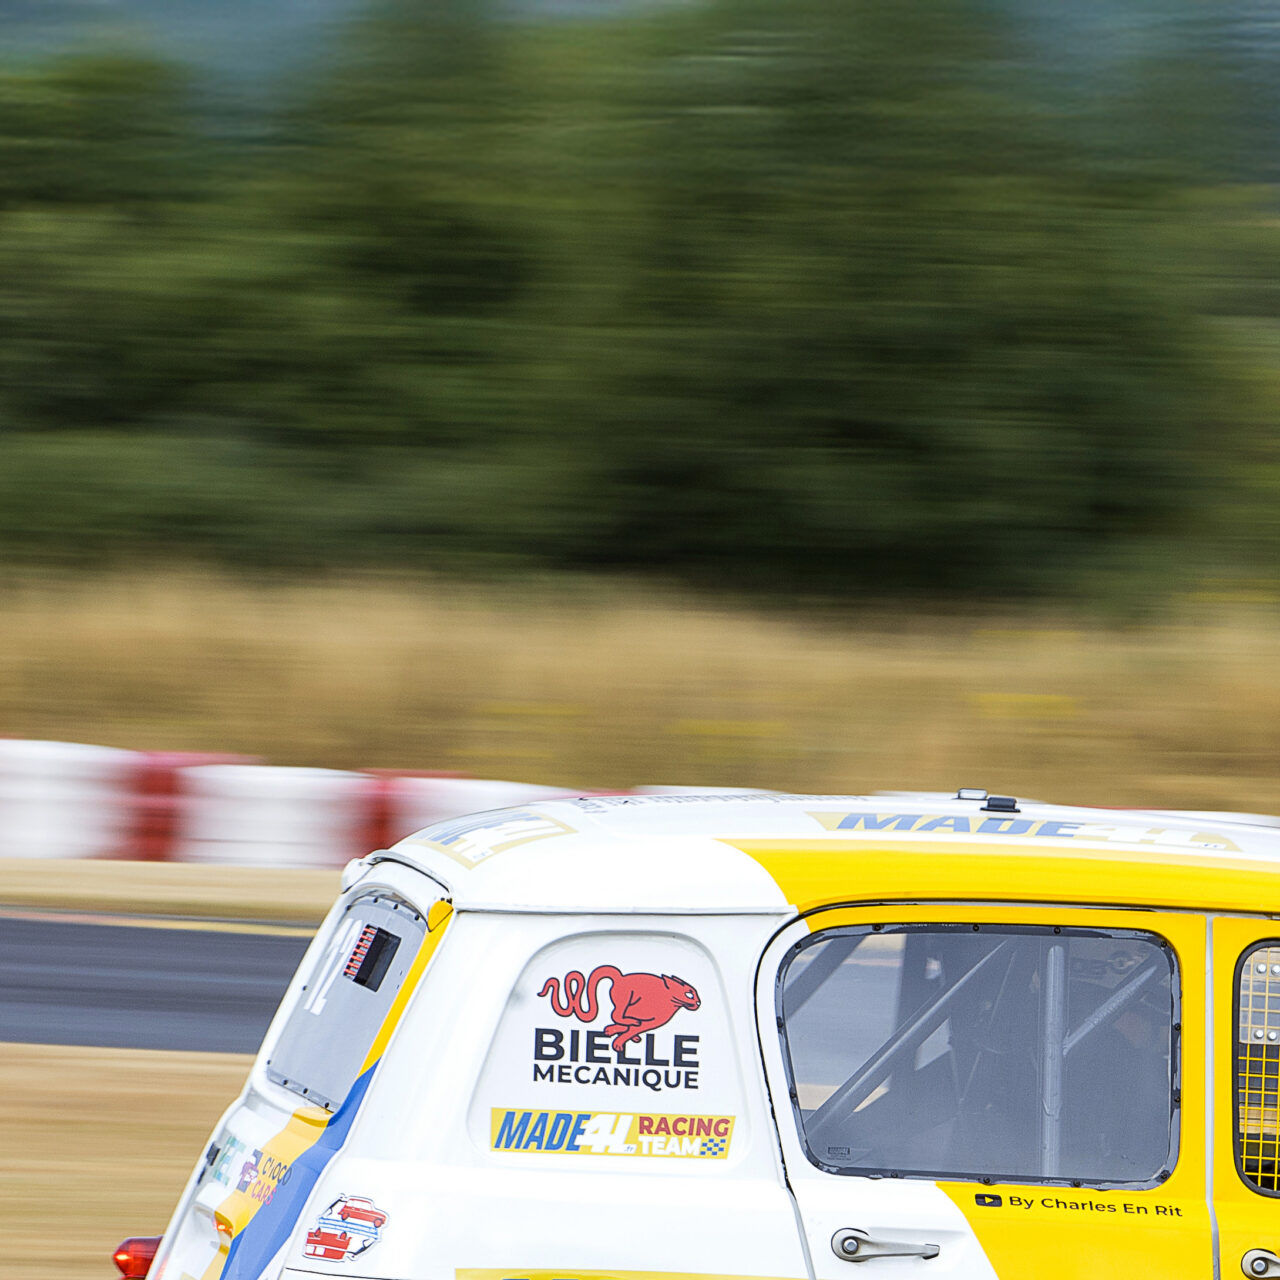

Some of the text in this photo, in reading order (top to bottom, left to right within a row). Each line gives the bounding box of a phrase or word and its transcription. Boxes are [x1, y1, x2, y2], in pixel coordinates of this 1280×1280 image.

[534, 1028, 699, 1067] BIELLE
[533, 1064, 699, 1091] MECANIQUE
[639, 1116, 731, 1137] RACING
[637, 1135, 701, 1156] TEAM
[1009, 1196, 1183, 1217] By Charles En Rit
